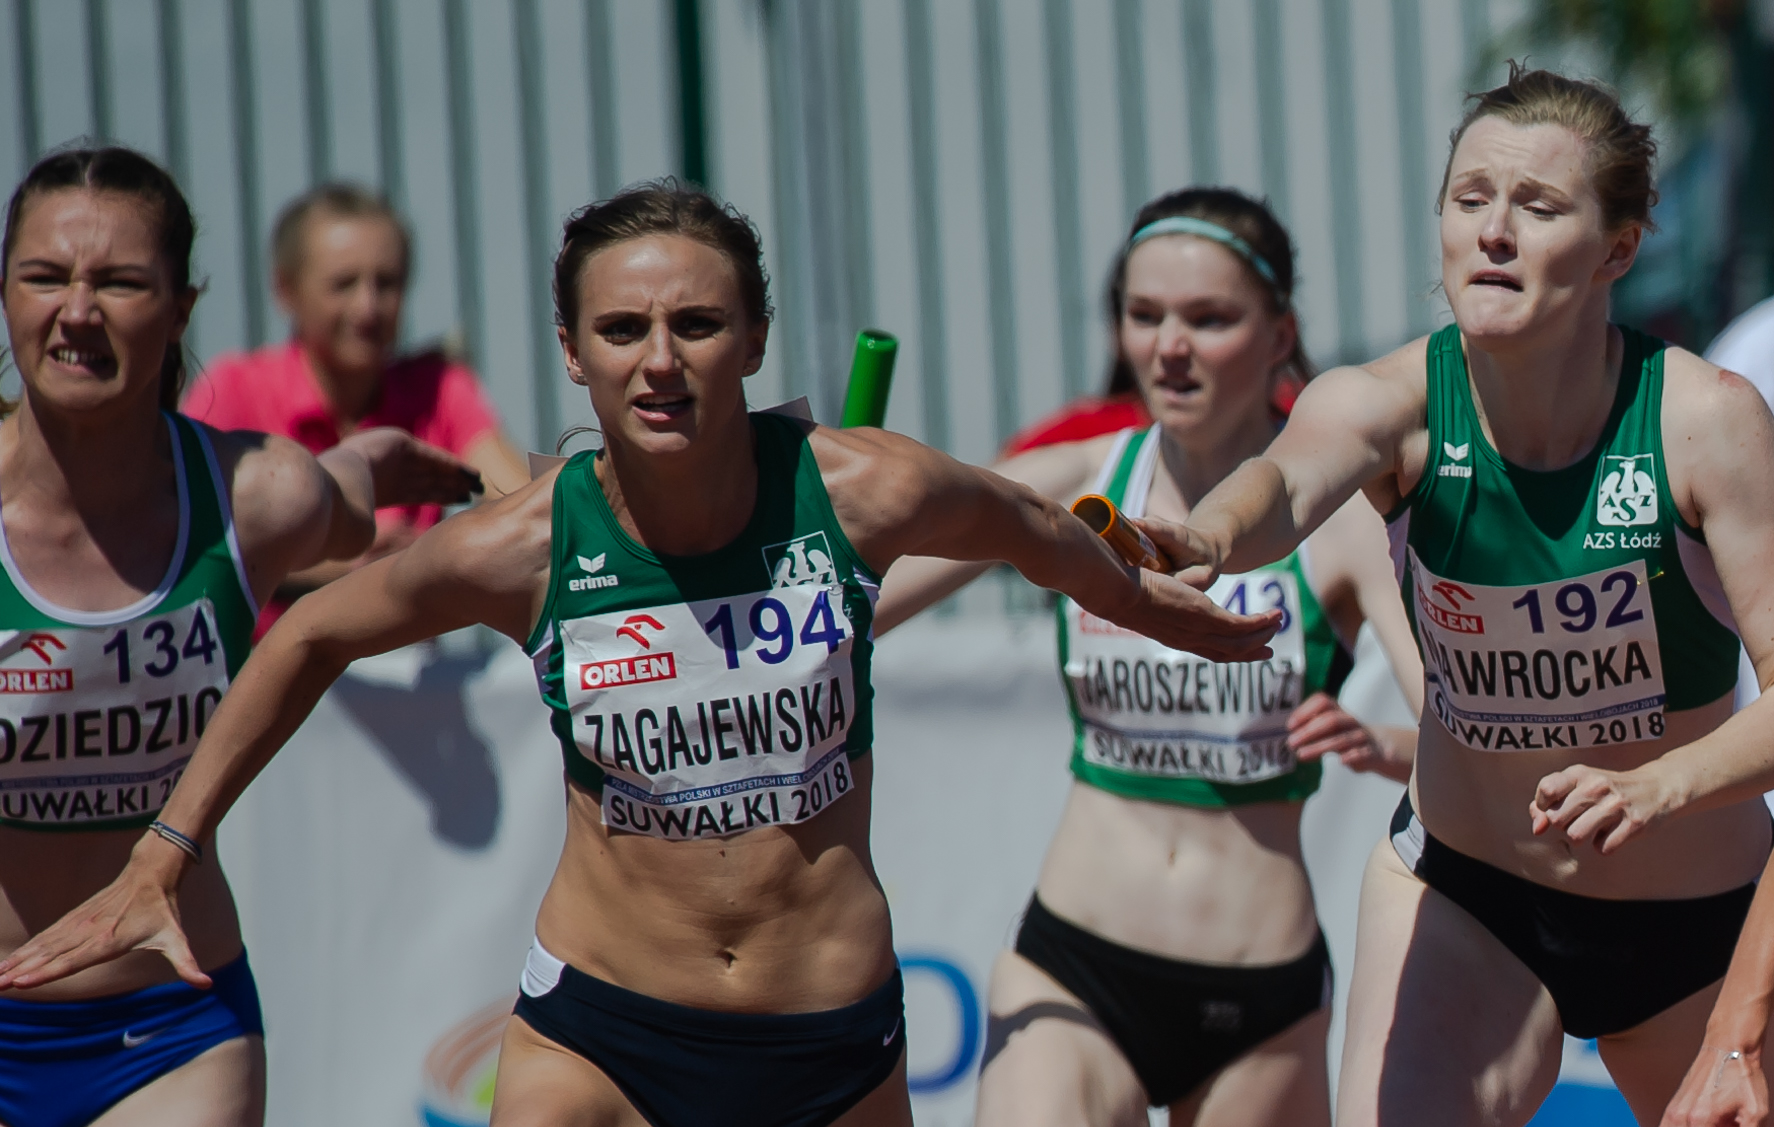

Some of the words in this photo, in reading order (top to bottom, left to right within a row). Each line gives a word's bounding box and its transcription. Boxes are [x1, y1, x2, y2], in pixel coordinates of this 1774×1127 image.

[1583, 532, 1616, 549] AZS
[1620, 532, 1662, 549] Łódź
[568, 573, 619, 592] erima
[1513, 570, 1645, 634] 192
[103, 607, 218, 685] 134
[704, 590, 846, 670] 194
[584, 656, 672, 686] ORLEN
[1420, 620, 1652, 700] NAWROCKA
[584, 677, 847, 776] ZAGAJEWSKA
[1433, 691, 1579, 750] SUWAŁKI
[1589, 711, 1665, 746] 2018
[1483, 713, 1513, 723] POLSKI
[1514, 714, 1522, 723] W
[1523, 714, 1575, 724] SZTAFETACH
[1640, 698, 1659, 710] 2018
[2, 785, 149, 820] UWAŁKI
[610, 791, 781, 837] SUWAŁKI
[791, 761, 848, 821] 2018
[679, 788, 712, 804] POLSKI
[712, 786, 721, 798] W
[722, 778, 777, 795] SZTAFETACH
